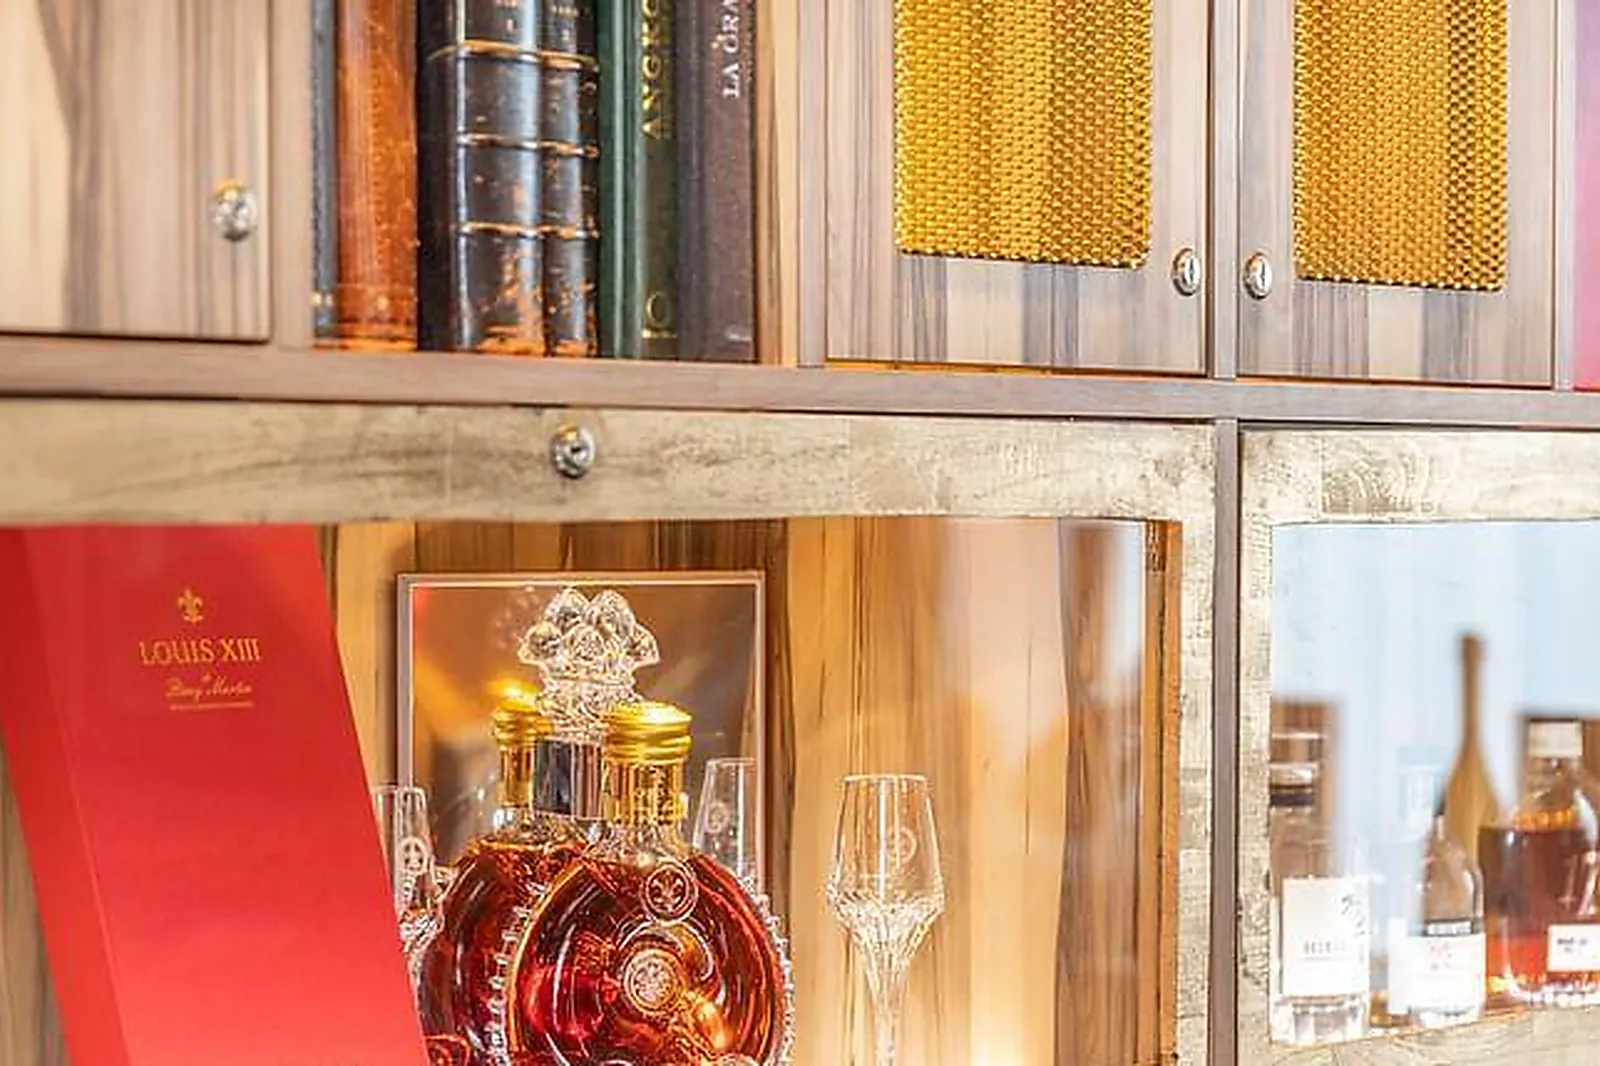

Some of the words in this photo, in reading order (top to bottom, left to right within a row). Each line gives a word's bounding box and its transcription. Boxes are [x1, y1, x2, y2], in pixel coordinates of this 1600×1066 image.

[722, 62, 740, 99] LA
[139, 637, 215, 666] LOUIS
[219, 636, 262, 663] XIII
